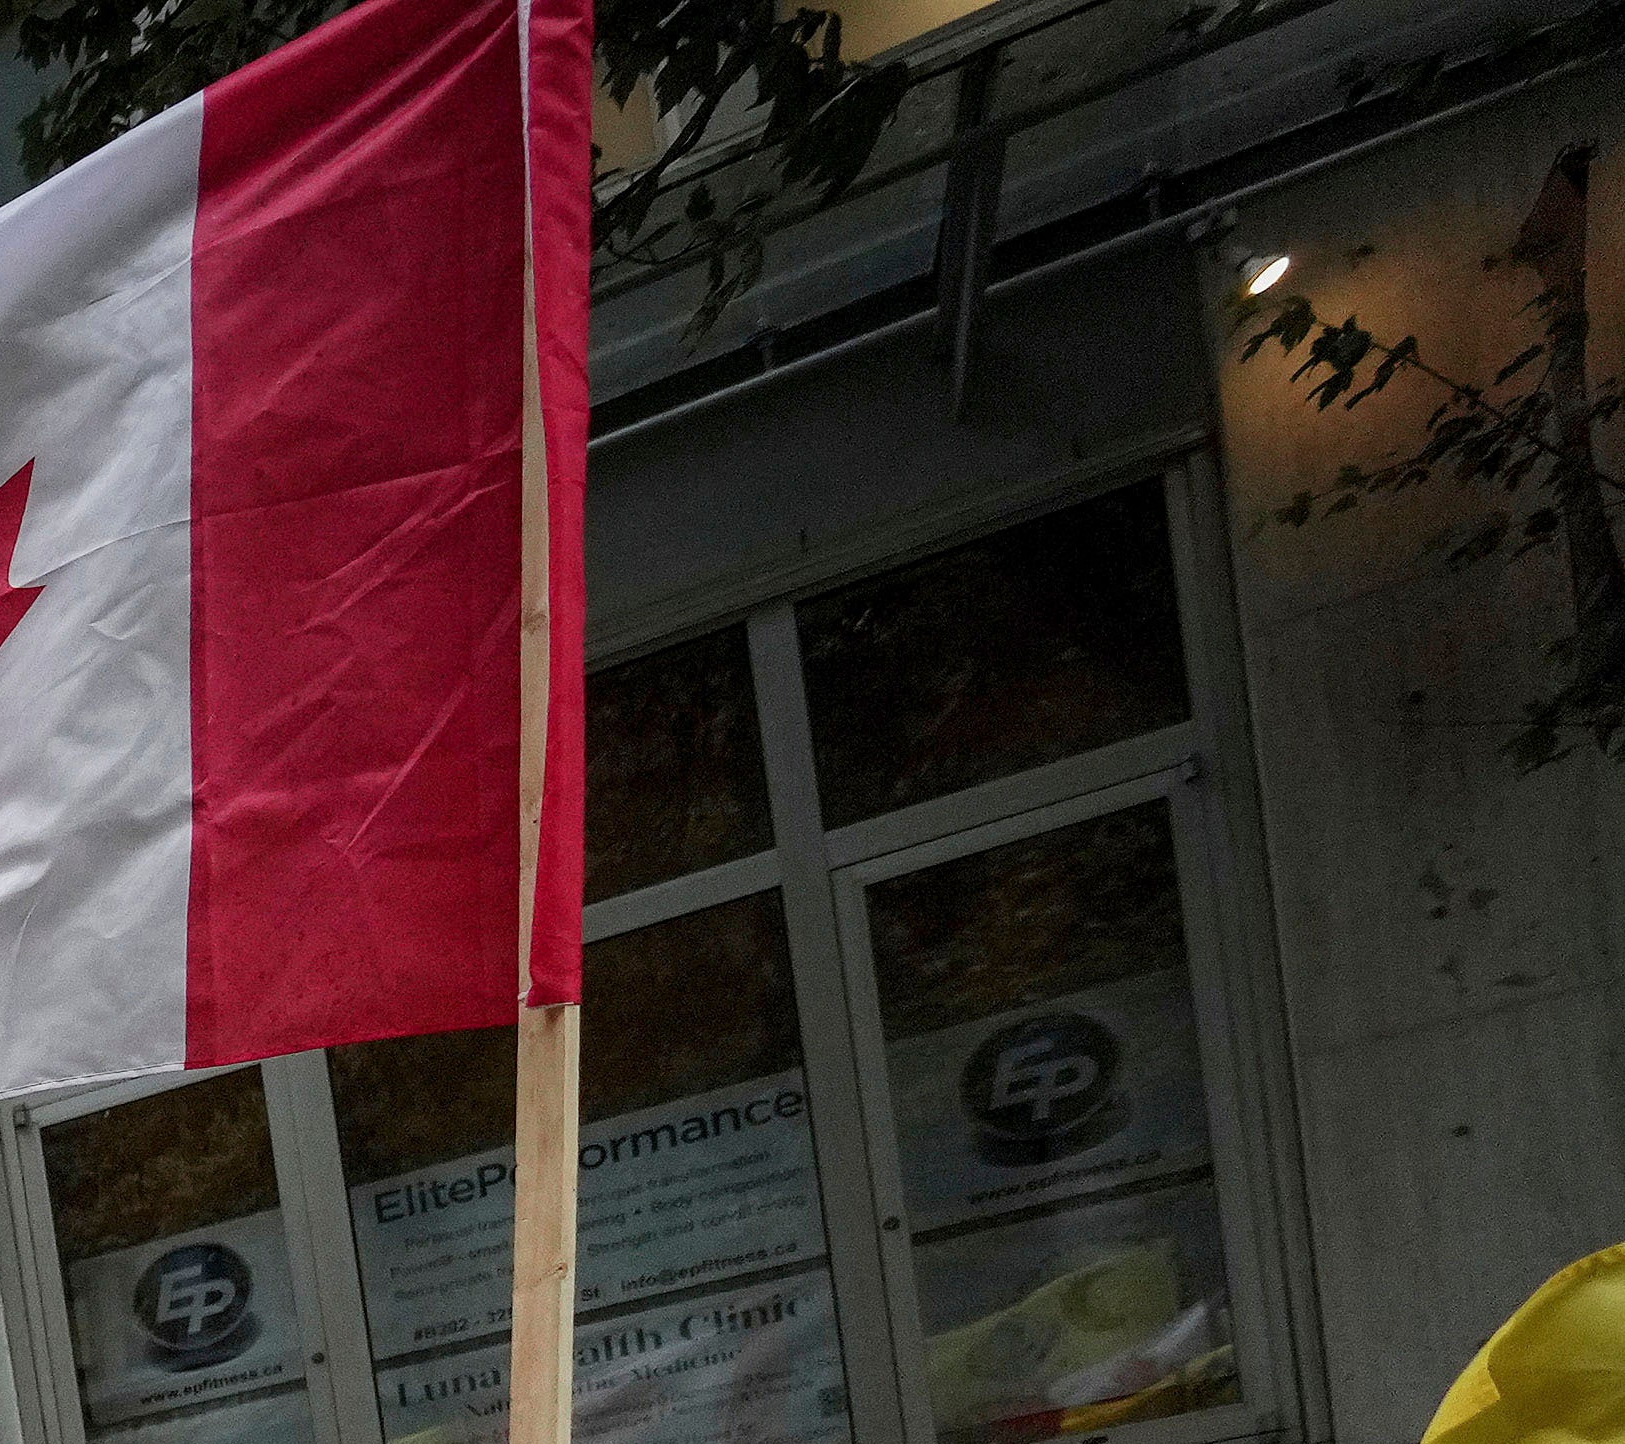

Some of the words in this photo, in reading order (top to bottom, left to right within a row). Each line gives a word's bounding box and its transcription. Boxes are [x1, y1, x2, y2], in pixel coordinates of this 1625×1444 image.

[374, 1086, 805, 1225] ElitePormance
[157, 1264, 235, 1335] EP
[576, 1328, 662, 1368] alth
